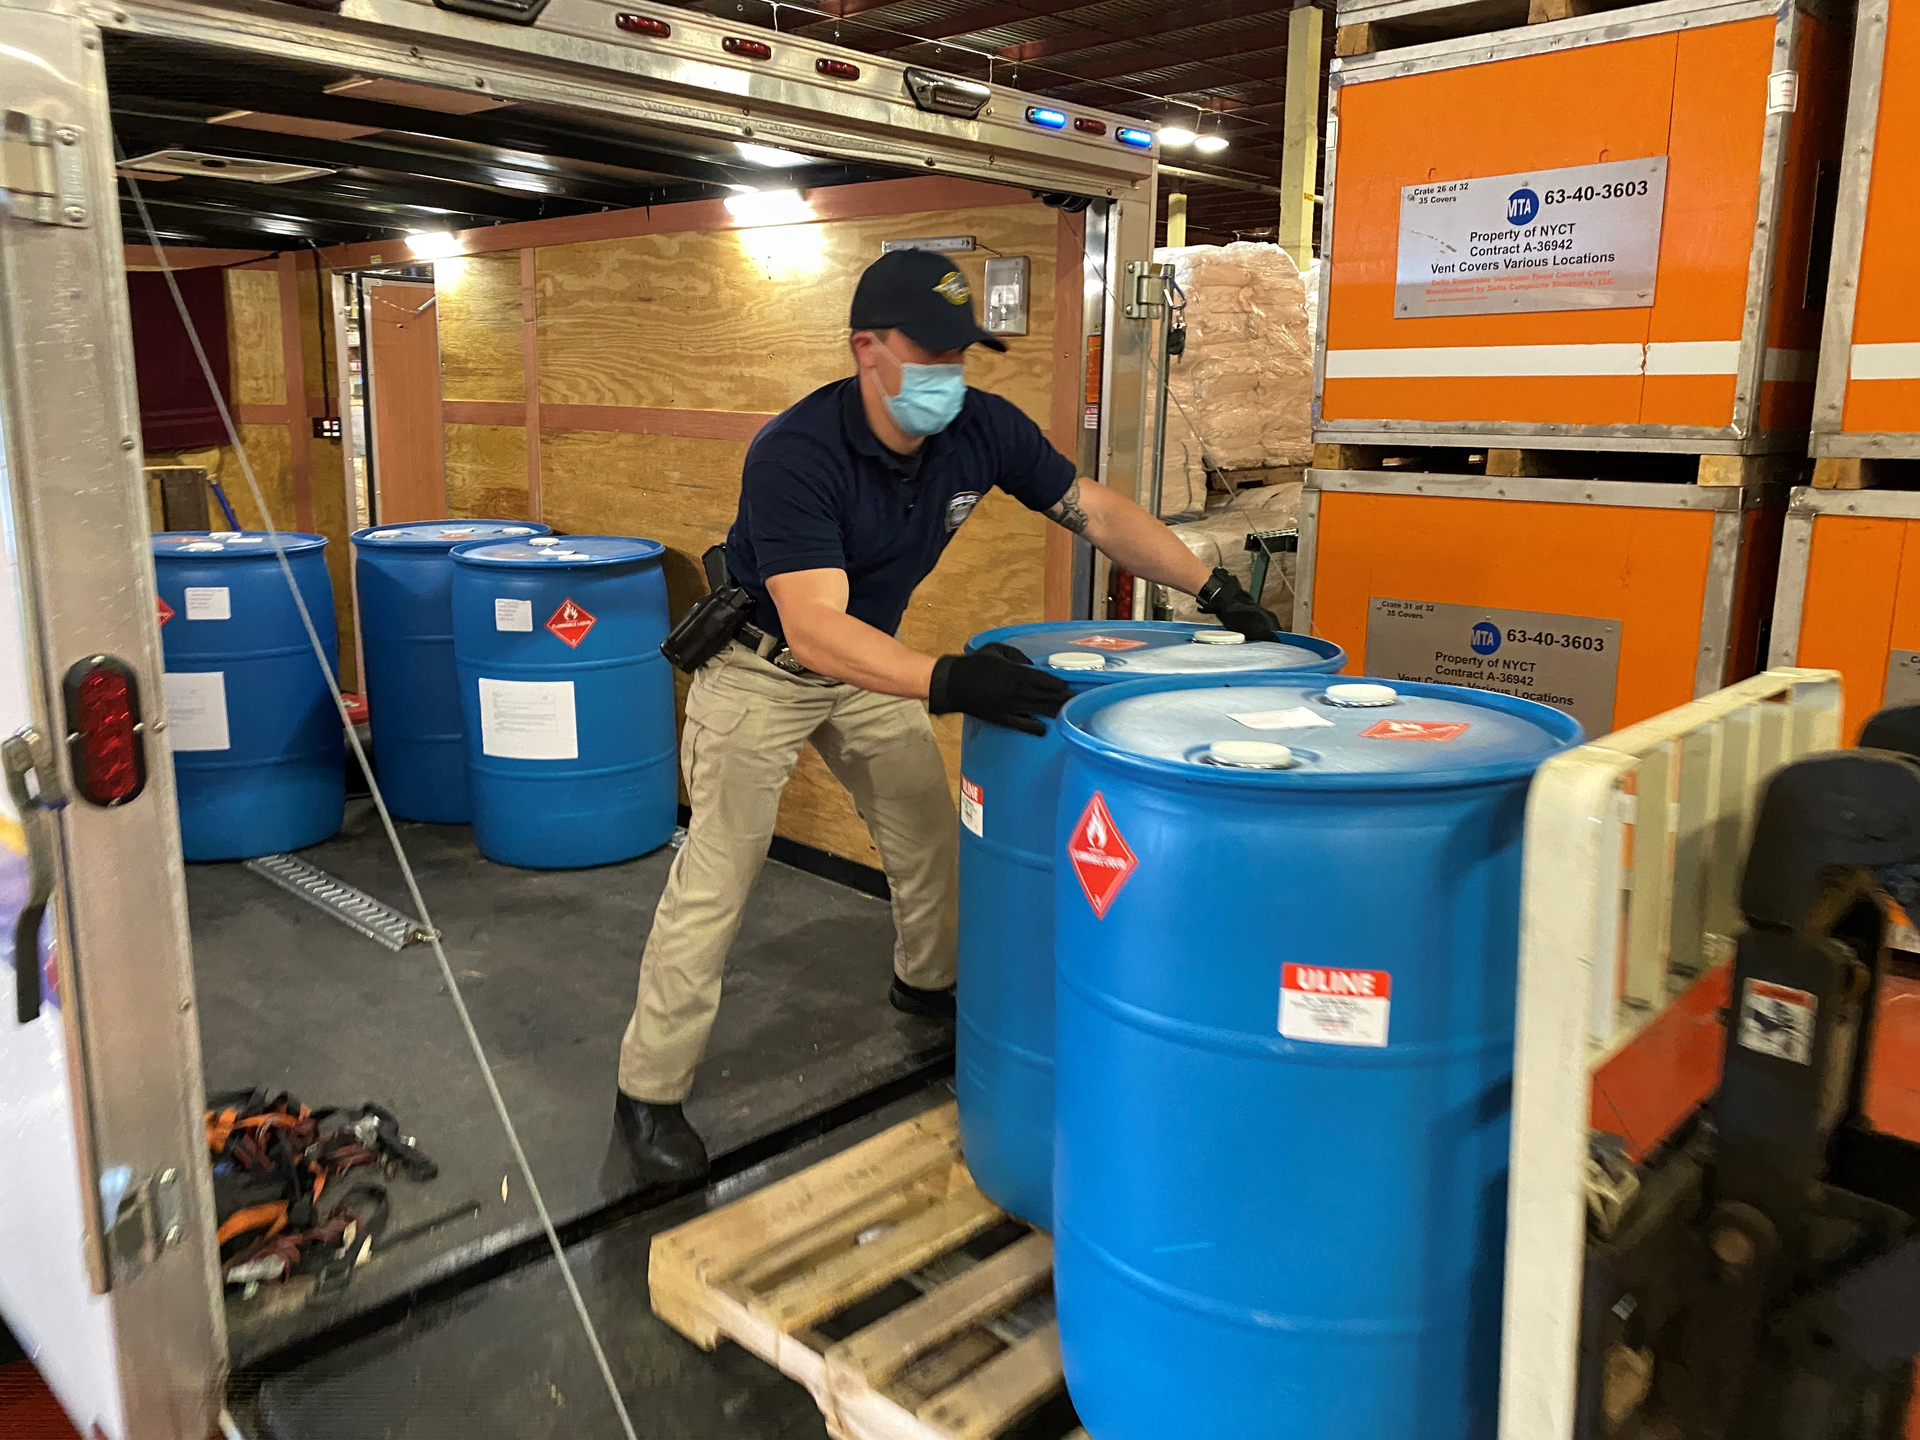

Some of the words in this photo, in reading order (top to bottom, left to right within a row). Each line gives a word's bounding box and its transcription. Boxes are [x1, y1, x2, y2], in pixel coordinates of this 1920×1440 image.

[1414, 188, 1434, 196] Crate
[1437, 185, 1446, 193] 26
[1449, 184, 1457, 192] of
[1459, 183, 1469, 191] 32
[1431, 195, 1457, 203] Covers
[1544, 180, 1648, 205] 63-40-3603
[1507, 198, 1531, 218] MTA
[1470, 229, 1520, 243] Property
[1524, 226, 1537, 238] of
[1540, 223, 1576, 237] NYCT
[1470, 243, 1520, 257] Contract
[1523, 238, 1573, 253] A-36942
[1431, 262, 1456, 274] Vent
[1459, 258, 1499, 272] Covers
[1504, 255, 1548, 269] Various
[1552, 252, 1615, 266] Locations
[1398, 611, 1423, 619] Covers
[1470, 629, 1494, 646] MTA
[1507, 629, 1604, 652] 63-40-3603
[1435, 651, 1484, 669] Property
[1488, 658, 1500, 668] of
[1502, 659, 1537, 673] NYCT
[1435, 665, 1485, 680] Contract
[1486, 671, 1534, 687] A-36942
[1515, 688, 1574, 706] Locations
[1296, 966, 1376, 996] ULINE
